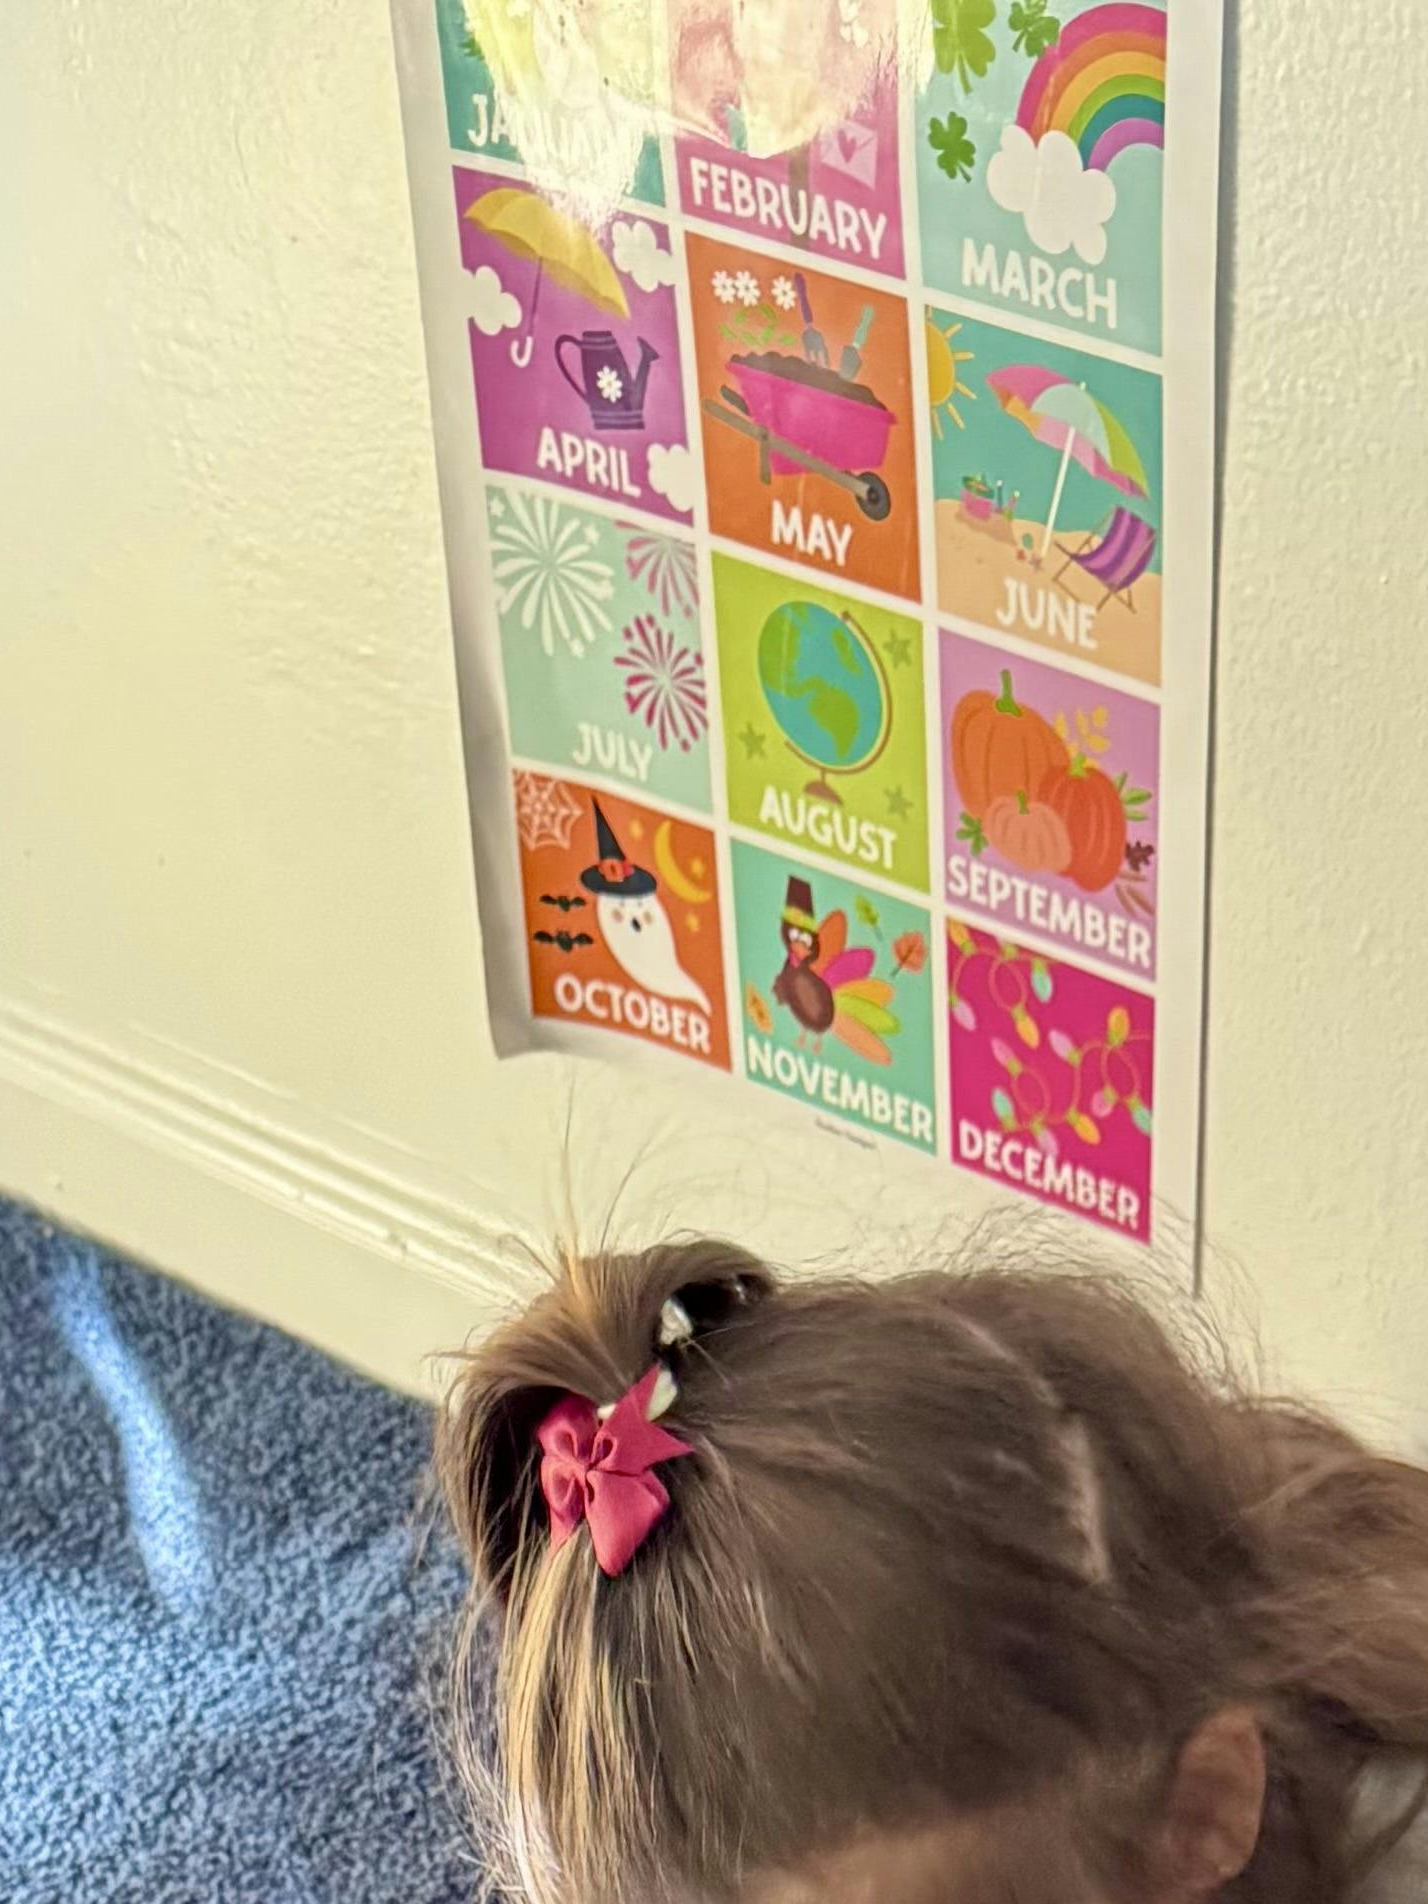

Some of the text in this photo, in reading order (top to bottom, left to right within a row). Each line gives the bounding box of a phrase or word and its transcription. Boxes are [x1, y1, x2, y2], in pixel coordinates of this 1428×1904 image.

[690, 157, 888, 261] FEBRUARY
[961, 237, 1118, 330] MARCH
[536, 426, 642, 499] APRIL
[771, 505, 855, 567] MAY
[996, 578, 1099, 649] JUNE
[572, 722, 654, 782] JULY
[759, 786, 899, 871] AUGUST
[947, 854, 1153, 969] SEPTEMBER
[555, 973, 713, 1054] OCTOBER
[747, 1034, 937, 1144] NOVEMBER
[958, 1120, 1140, 1230] DECEMBER
